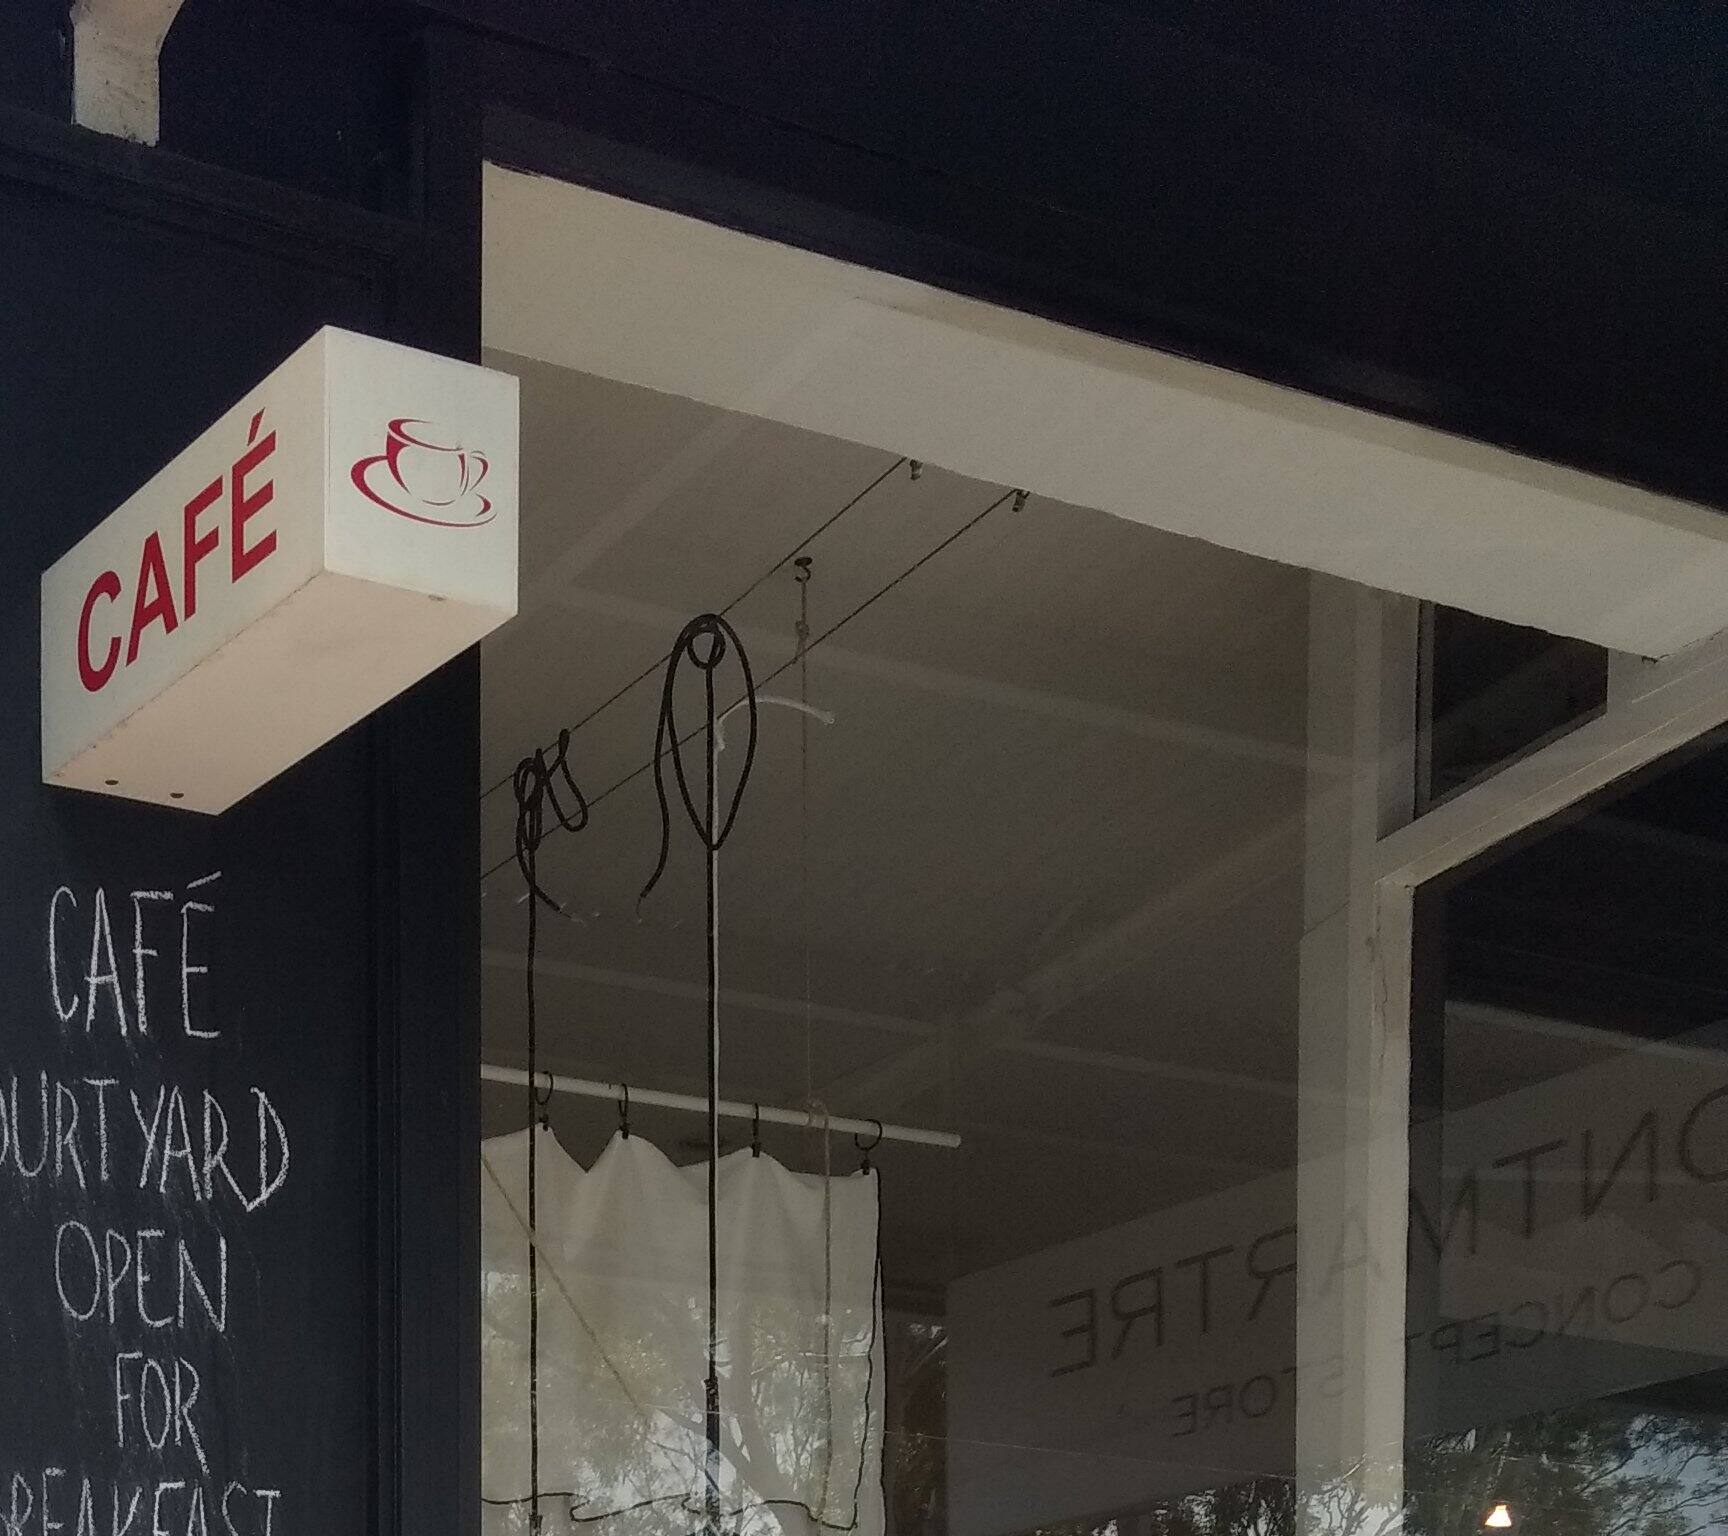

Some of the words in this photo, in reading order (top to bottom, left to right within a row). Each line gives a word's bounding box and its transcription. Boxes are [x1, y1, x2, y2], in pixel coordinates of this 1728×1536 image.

[77, 406, 277, 692] CAFÉ
[47, 870, 222, 1038] CAFÉ
[53, 1220, 228, 1333] OPEN
[113, 1351, 211, 1475] FOR
